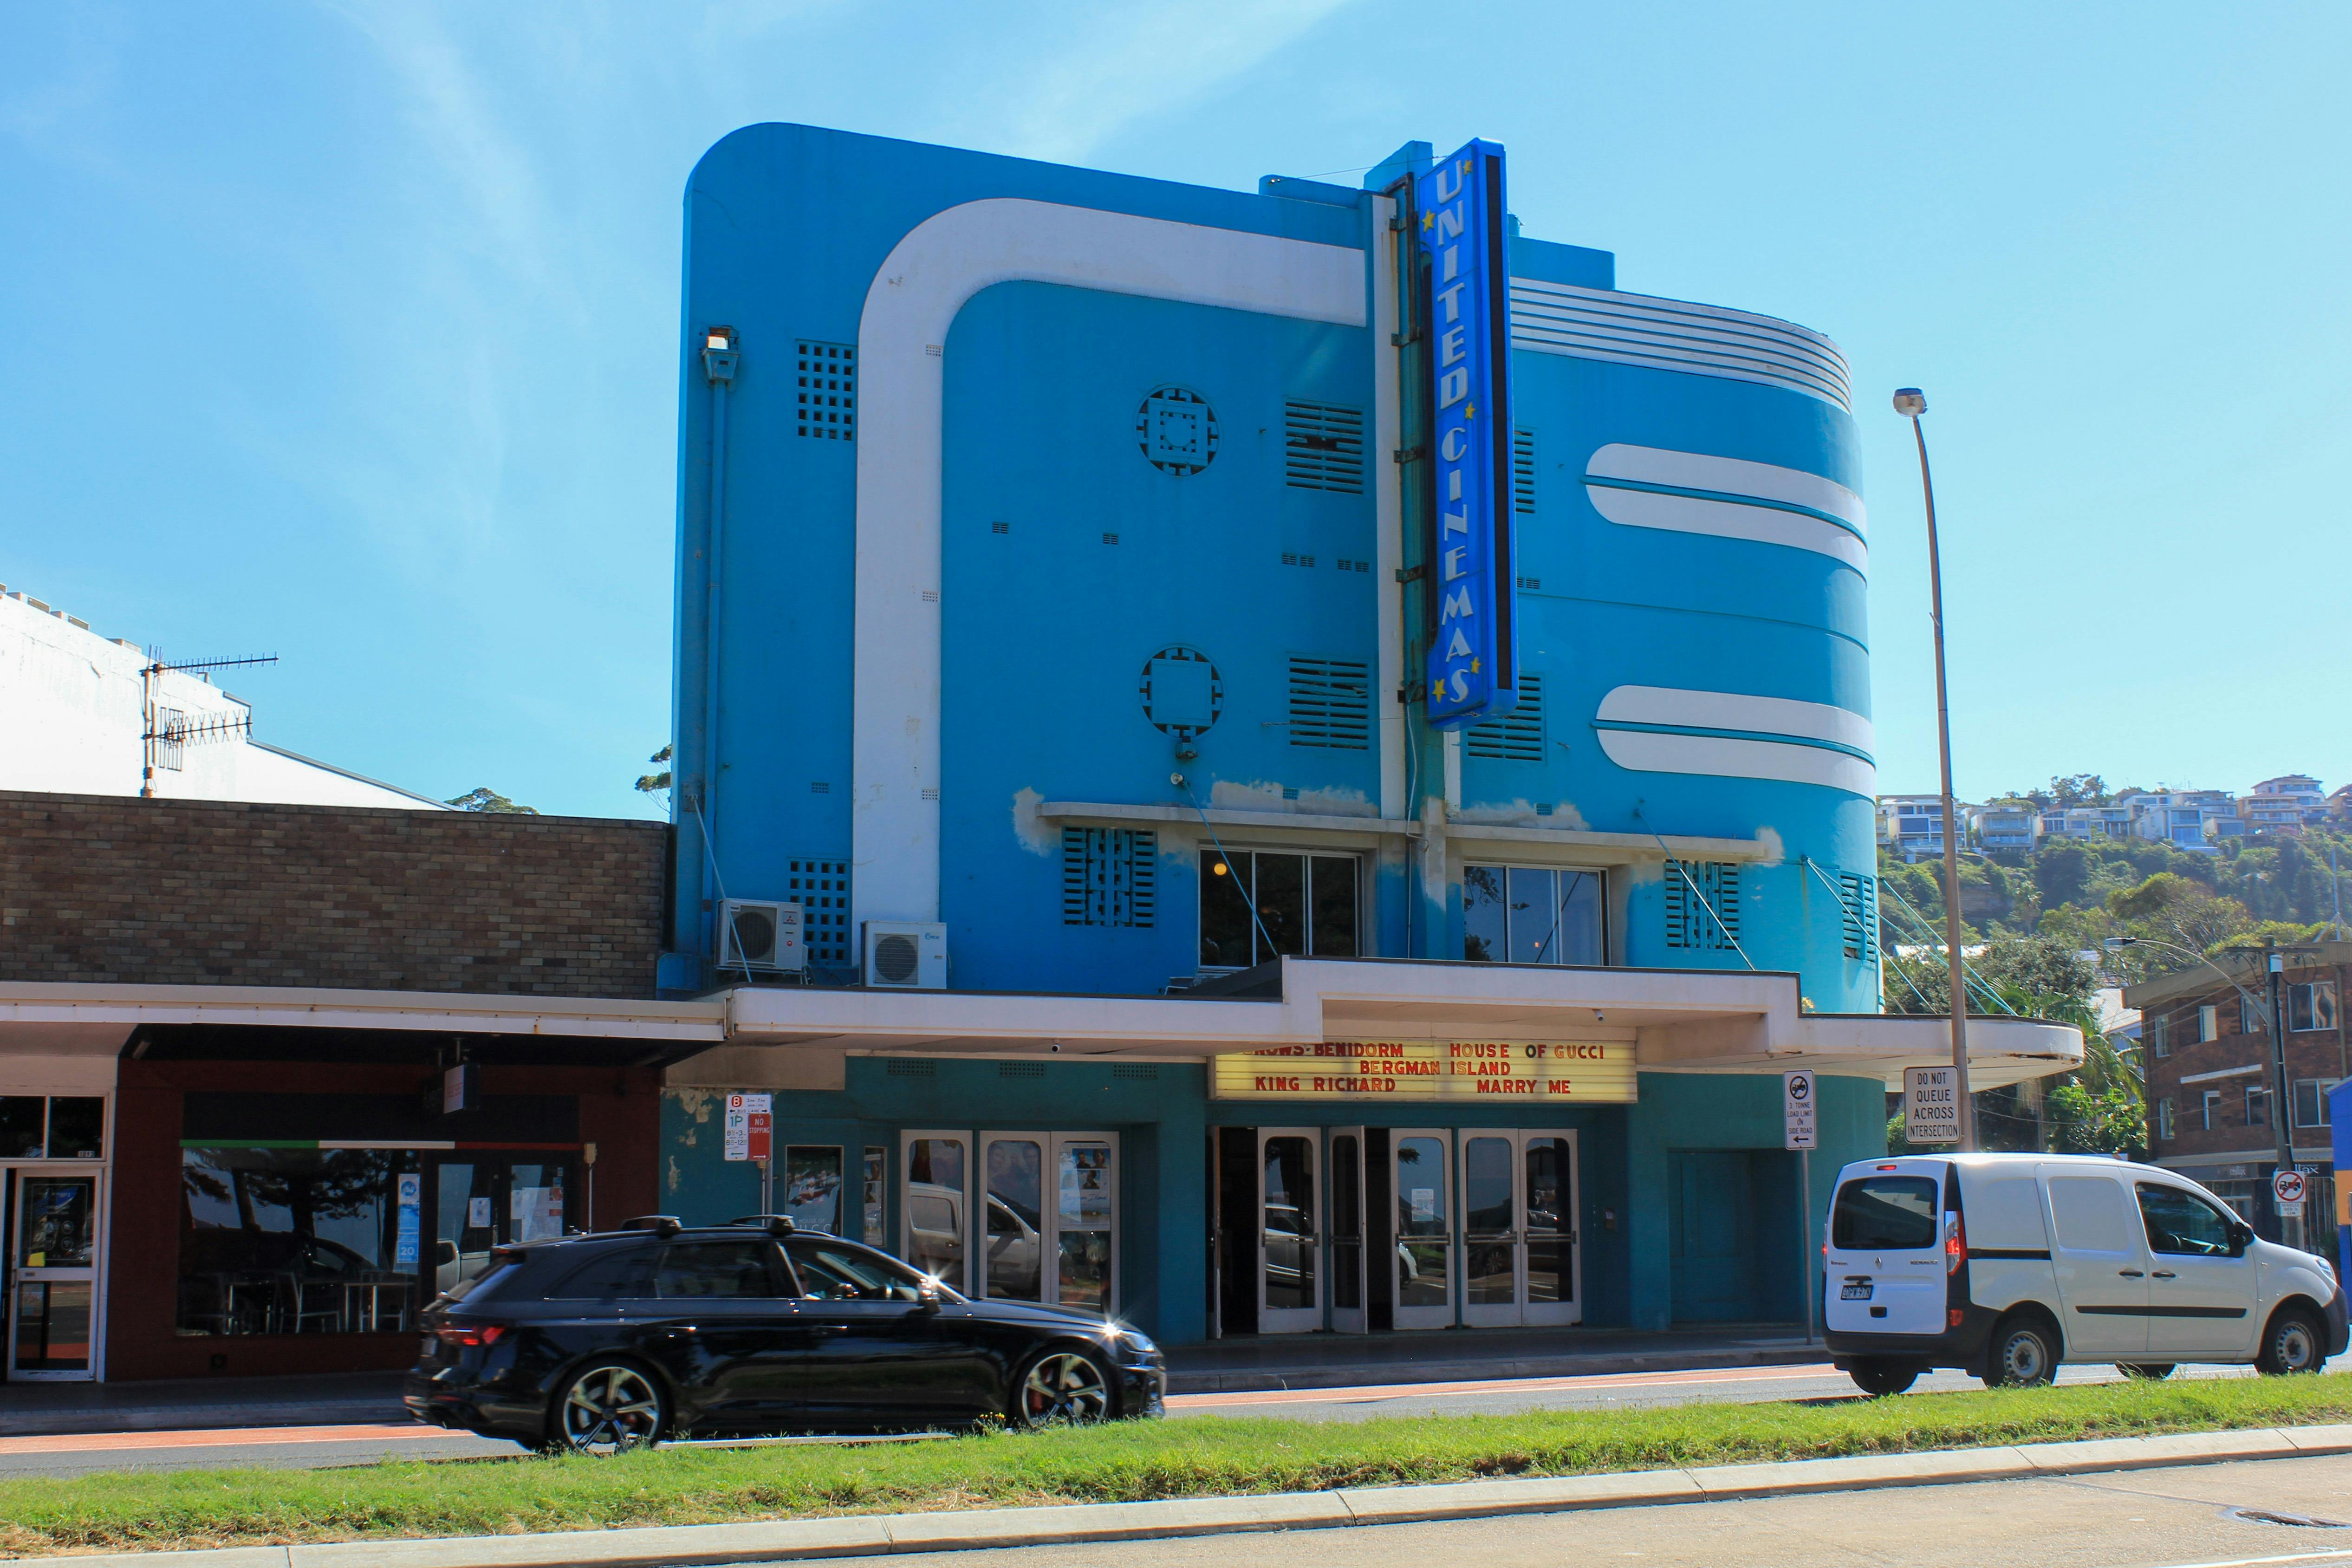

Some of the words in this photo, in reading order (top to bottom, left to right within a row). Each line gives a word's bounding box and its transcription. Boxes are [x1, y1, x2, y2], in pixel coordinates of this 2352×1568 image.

[1436, 159, 1468, 410] UNITED
[1441, 426, 1474, 703] CINEMAS
[1314, 1042, 1403, 1057] BENIDORM
[1450, 1043, 1509, 1058] HOUSE
[1525, 1044, 1547, 1058] OF
[1554, 1045, 1604, 1059] GUCCI
[1360, 1061, 1440, 1075] BERGMAN
[1450, 1061, 1511, 1075] ISLAND
[1255, 1077, 1299, 1091] KING
[1314, 1077, 1396, 1092] RICHARD
[1917, 1073, 1928, 1085] DO
[1931, 1072, 1946, 1084] NOT
[1477, 1080, 1537, 1093] MARRY
[1549, 1080, 1571, 1093] ME
[733, 1096, 741, 1106] B
[1917, 1089, 1951, 1102] QUEUE
[1914, 1107, 1954, 1119] ACROSS
[730, 1115, 743, 1127] 1P
[1908, 1125, 1958, 1137] INTERSECTION
[401, 1247, 415, 1256] 20
